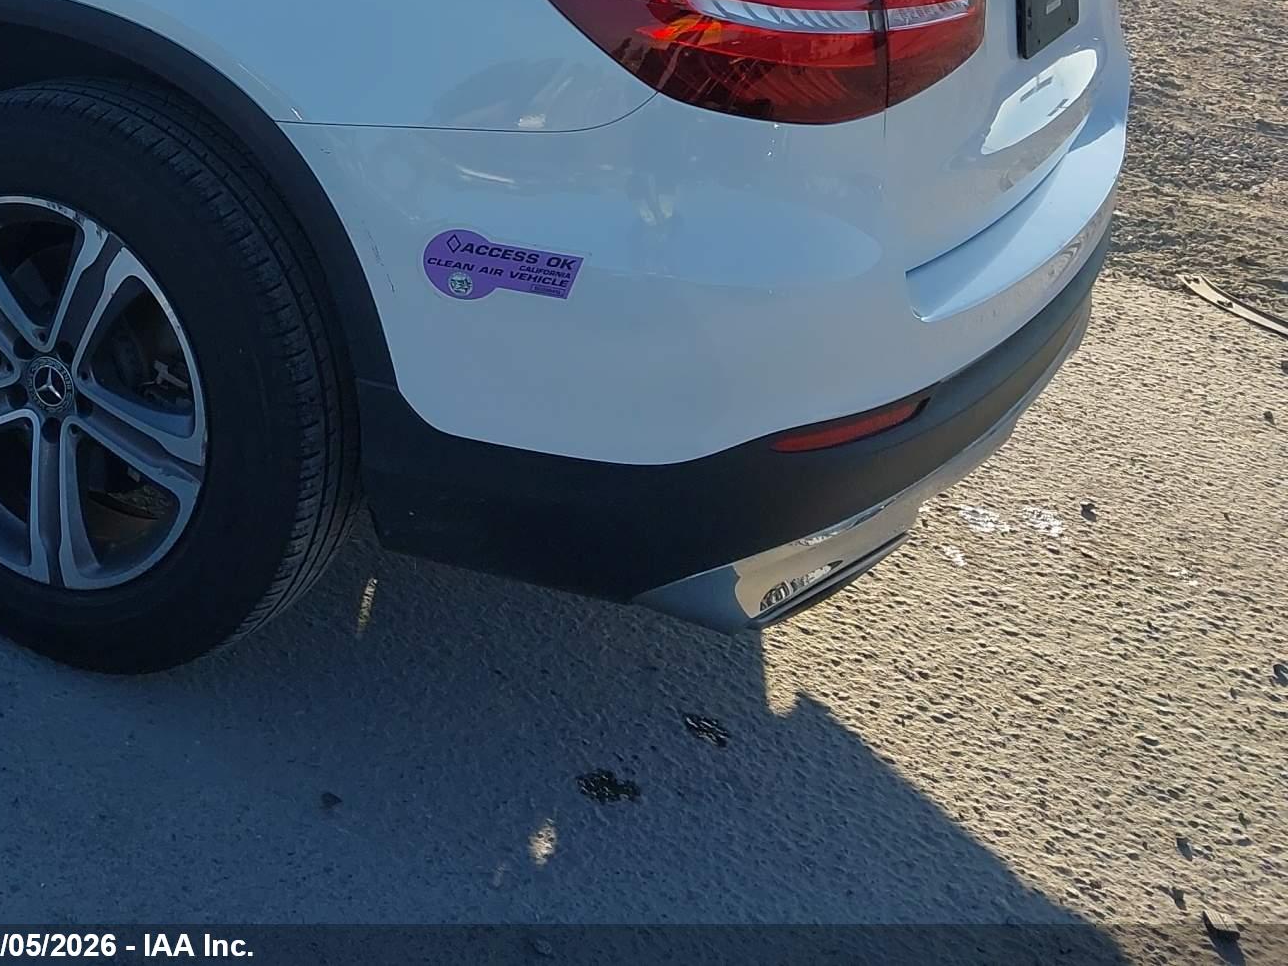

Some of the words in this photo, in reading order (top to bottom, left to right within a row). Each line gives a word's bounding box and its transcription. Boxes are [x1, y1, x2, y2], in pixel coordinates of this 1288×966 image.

[462, 242, 540, 265] ACCESS
[546, 256, 577, 271] OK
[427, 257, 475, 272] CLEAN
[478, 265, 505, 277] AIR
[509, 270, 570, 288] VEHICLE
[519, 265, 571, 279] CALIFORNIA
